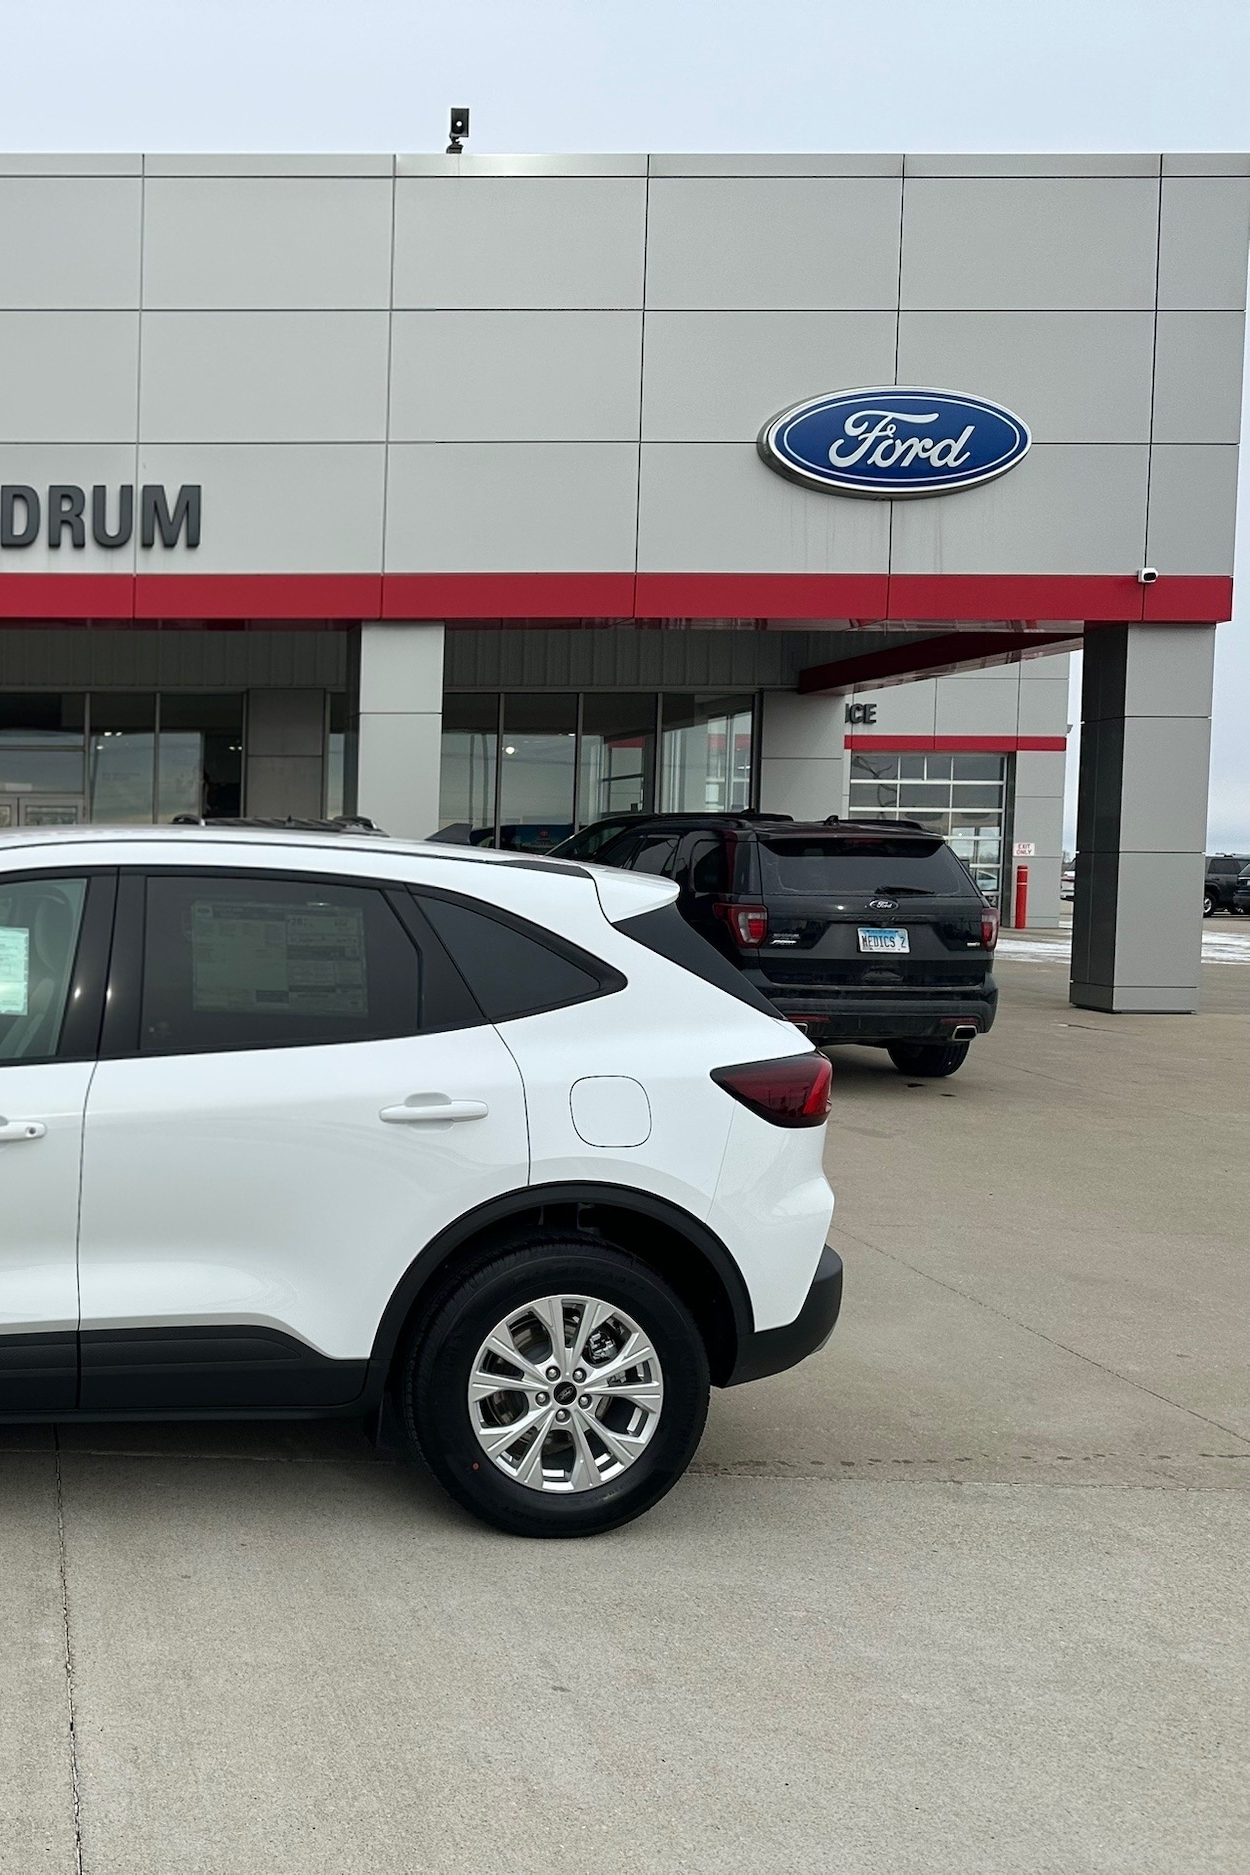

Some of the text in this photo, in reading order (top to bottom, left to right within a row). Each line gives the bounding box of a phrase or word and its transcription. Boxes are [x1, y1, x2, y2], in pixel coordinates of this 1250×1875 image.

[828, 409, 976, 468] Ford
[876, 900, 893, 909] Ford
[861, 935, 896, 948] MEDICS
